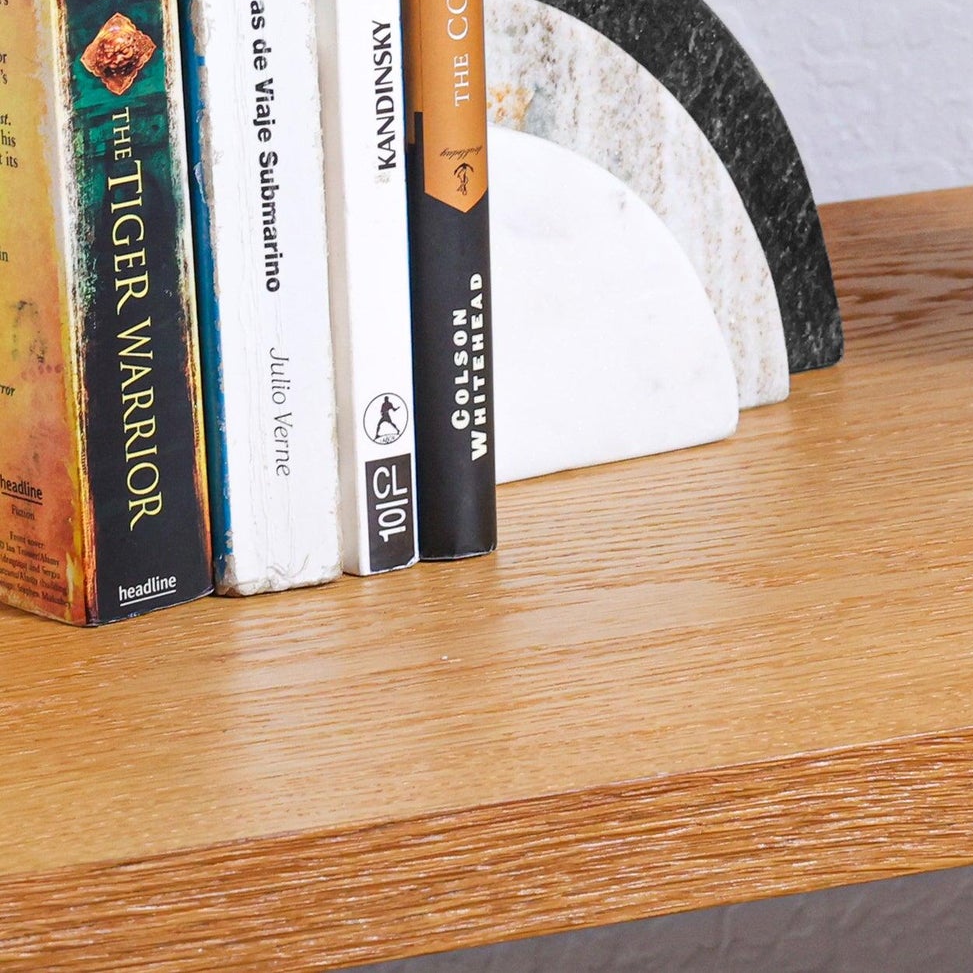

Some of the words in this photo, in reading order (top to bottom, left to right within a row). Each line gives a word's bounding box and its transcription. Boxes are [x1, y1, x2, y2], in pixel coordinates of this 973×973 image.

[252, 38, 272, 70] de
[453, 52, 470, 108] THE
[253, 77, 275, 143] Viaje
[372, 19, 397, 170] KANDINSKY
[111, 106, 132, 159] THE
[107, 159, 150, 316] TIGER
[258, 151, 283, 293] Submarino
[269, 346, 292, 406] Julio
[451, 308, 470, 430] COLSON
[469, 272, 489, 461] WHITEHEAD
[117, 317, 162, 531] WARRIOR
[273, 411, 294, 477] Verne
[0, 475, 43, 500] headline
[118, 575, 178, 602] headline
